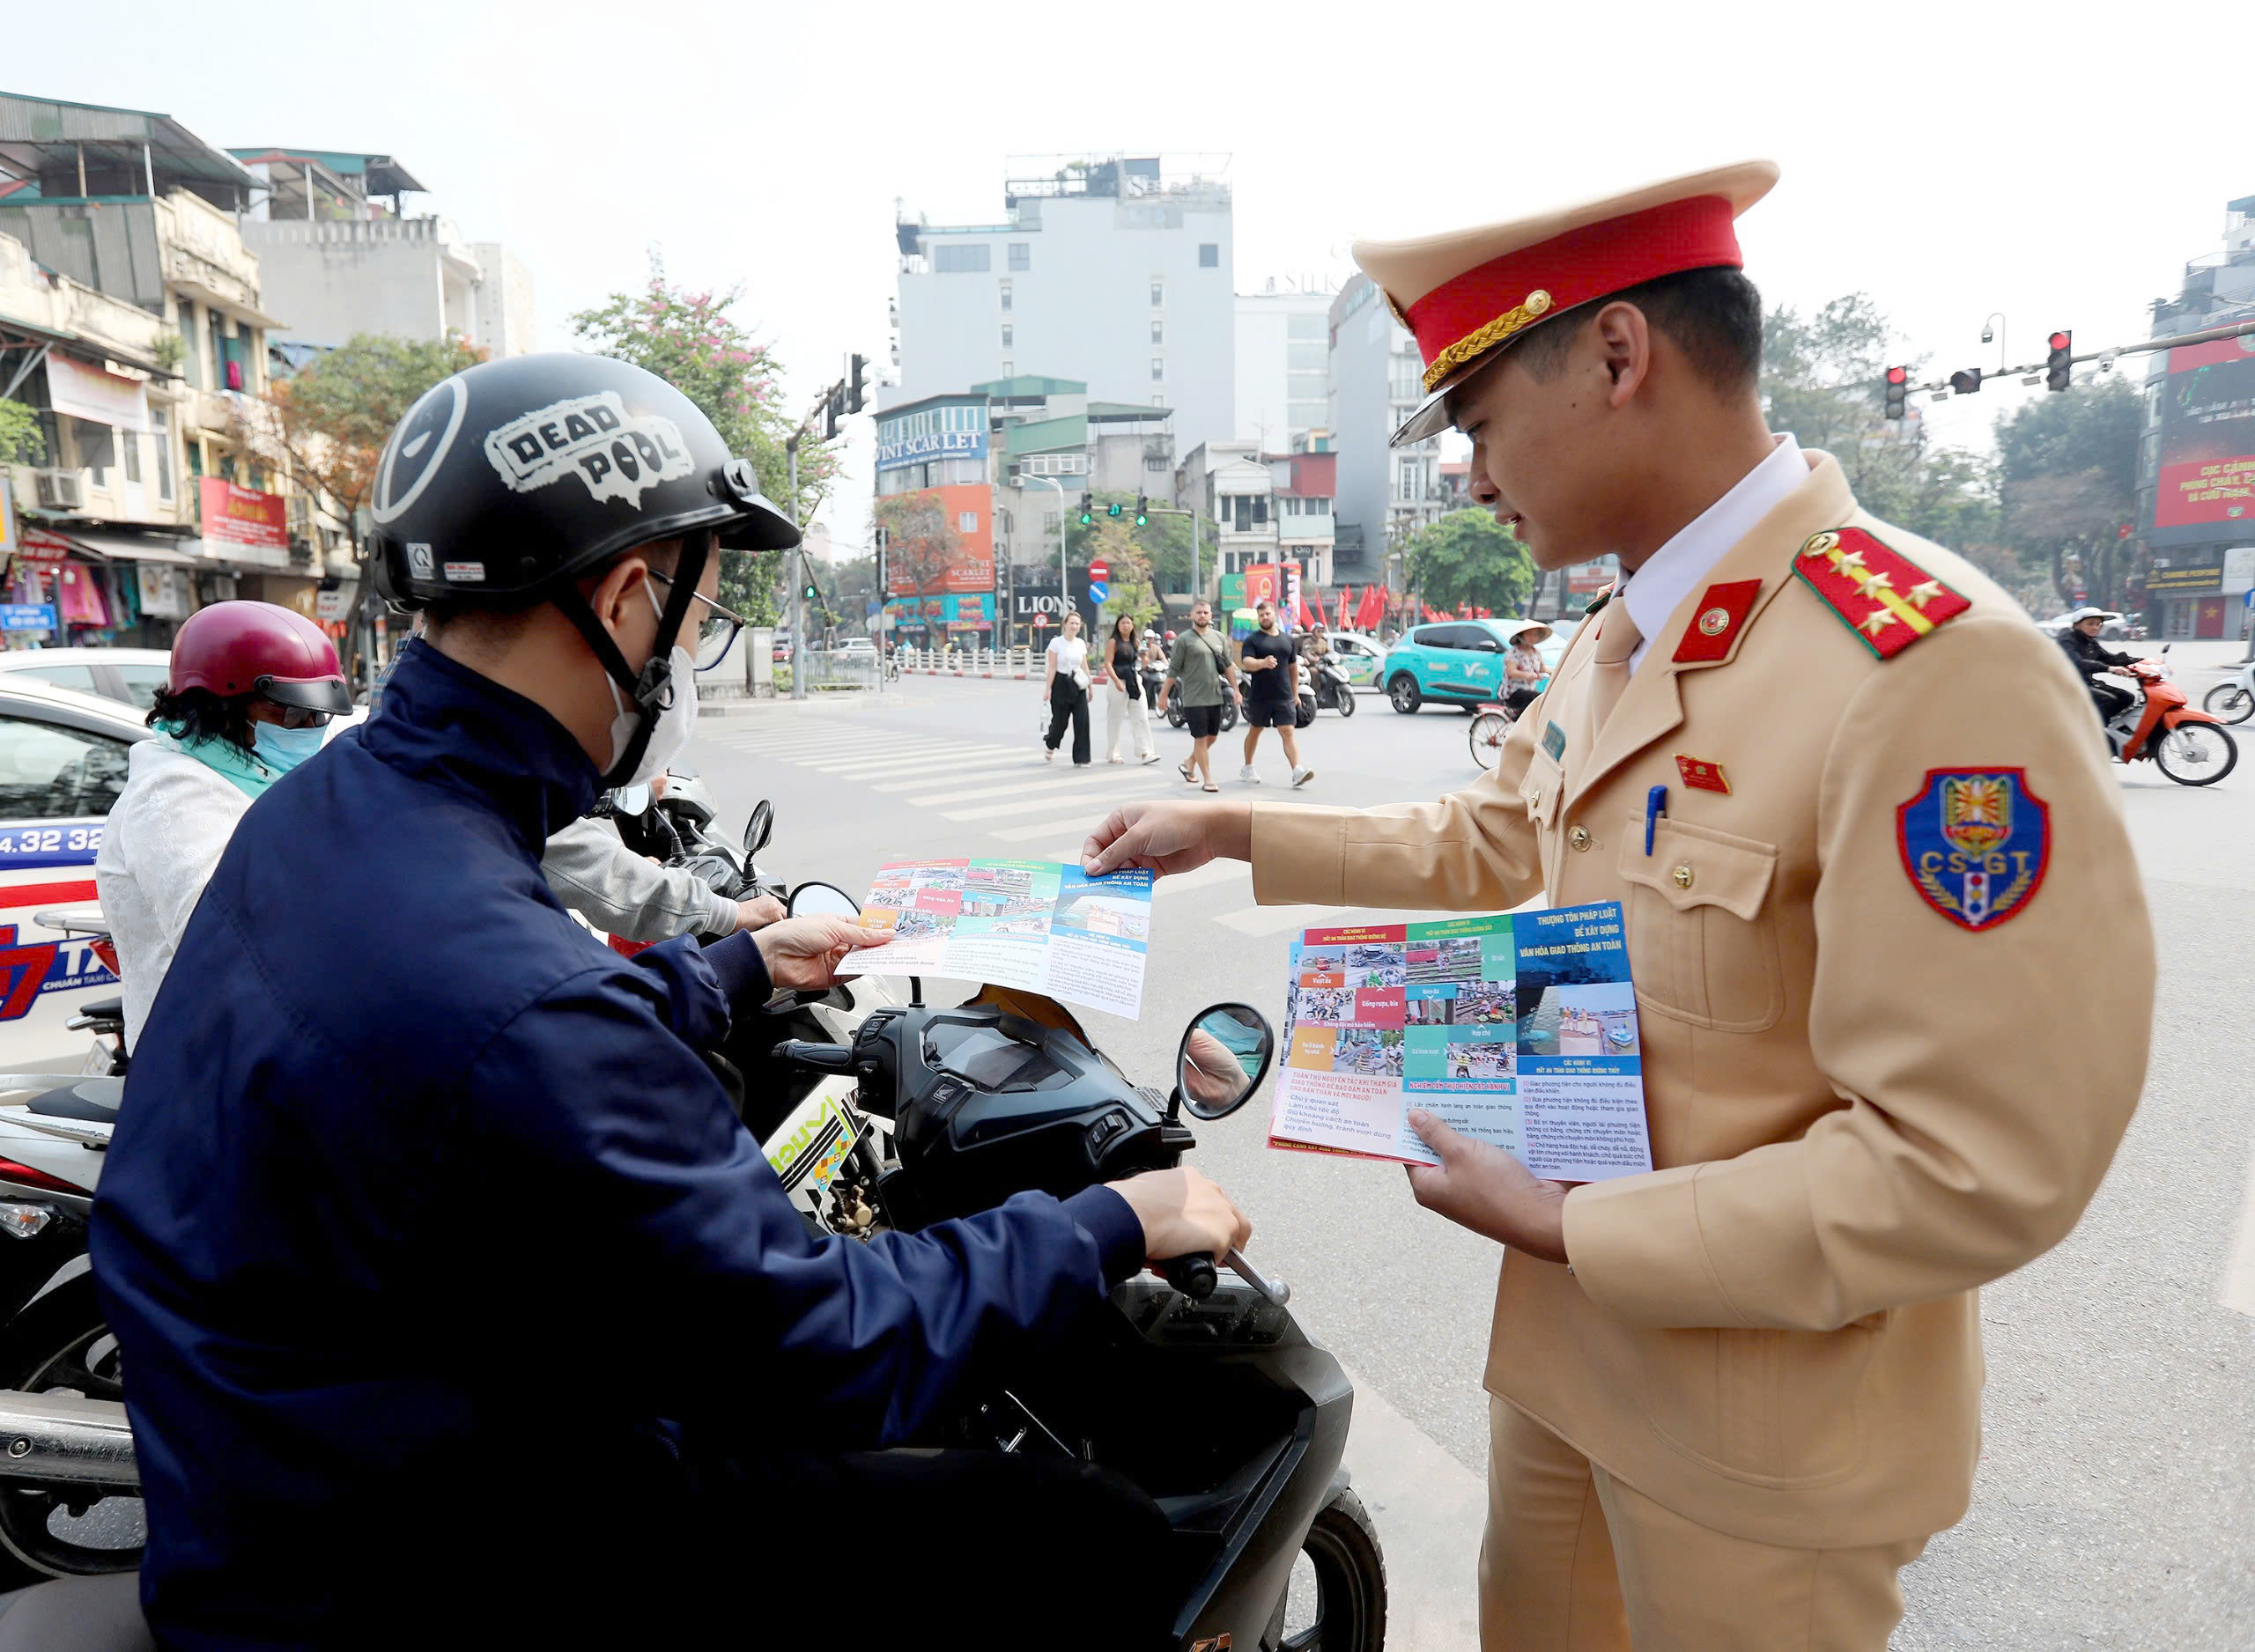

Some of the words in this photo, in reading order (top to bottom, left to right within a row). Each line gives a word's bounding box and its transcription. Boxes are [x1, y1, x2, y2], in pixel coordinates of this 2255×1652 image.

[506, 404, 620, 466] DEAD
[906, 431, 982, 455] SCARLET
[578, 431, 683, 485] POOL
[1018, 595, 1077, 614] LIONS
[1537, 915, 1564, 926] THƯỢNG
[1565, 912, 1578, 923] TÔN
[1579, 910, 1598, 921] PHÁP
[1599, 907, 1616, 919] LUẬT
[1574, 924, 1585, 937] ĐỂ
[1586, 925, 1598, 936] XÂY
[1600, 925, 1619, 936] DỰNG
[1519, 948, 1534, 957] VĂN
[1534, 946, 1549, 956] HÓA
[1549, 946, 1566, 955] GIAO
[1566, 941, 1589, 954] THÔNG
[1591, 942, 1601, 951] AN
[1601, 939, 1622, 950] TOÀN
[1306, 1080, 1325, 1088] THÔNG
[1322, 1074, 1346, 1083] NGUYÊN
[1409, 1080, 1432, 1090] NGHIÊM
[1460, 1081, 1474, 1092] HIỆN
[1475, 1081, 1486, 1091] CÁC
[1487, 1081, 1504, 1091] HÀNH
